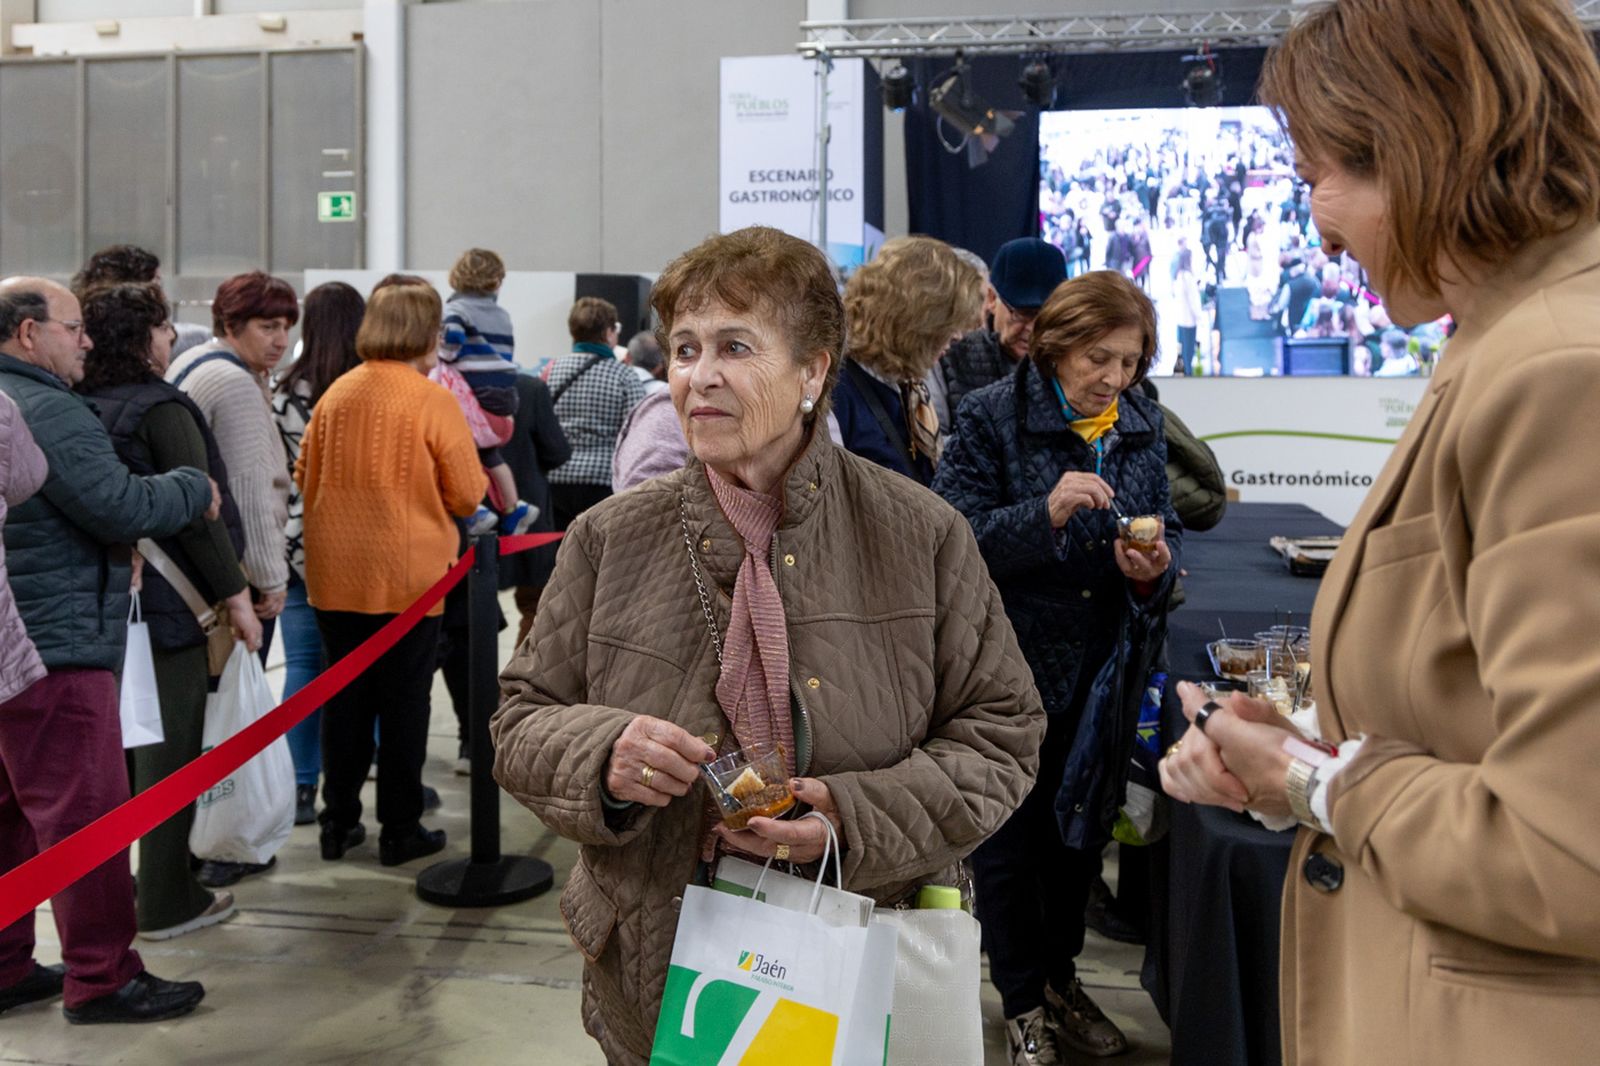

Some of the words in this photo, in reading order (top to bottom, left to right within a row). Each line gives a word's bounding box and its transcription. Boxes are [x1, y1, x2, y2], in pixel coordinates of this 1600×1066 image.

[749, 169, 834, 182] ESCENARO
[1231, 470, 1373, 487] Gastronómico
[752, 954, 787, 980] Jaén
